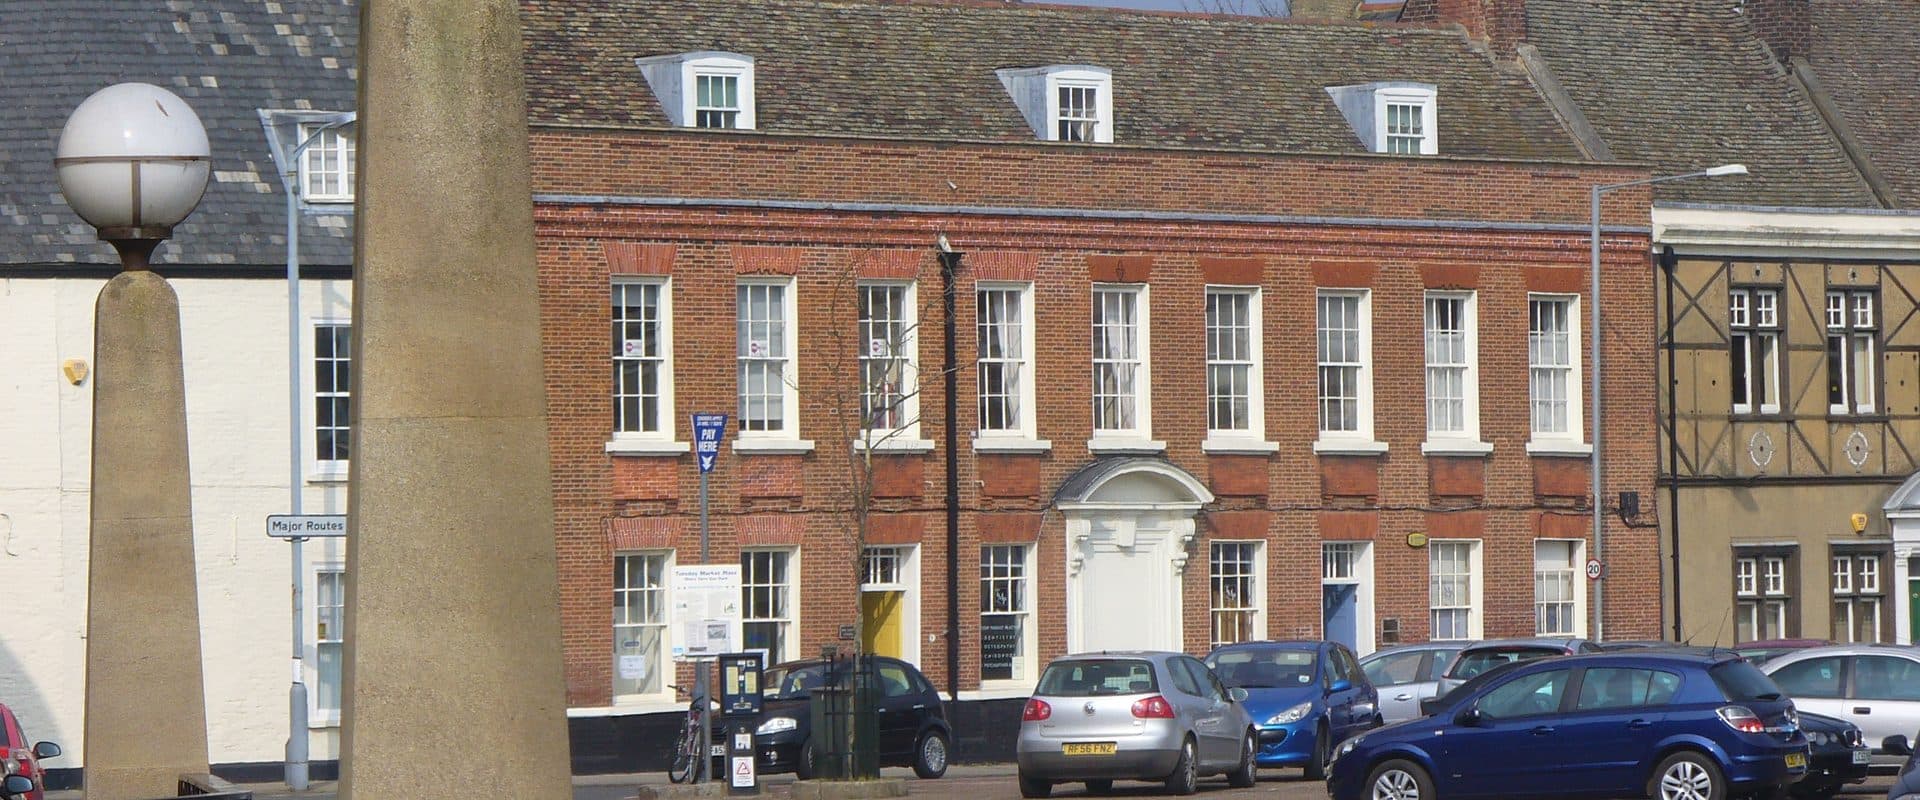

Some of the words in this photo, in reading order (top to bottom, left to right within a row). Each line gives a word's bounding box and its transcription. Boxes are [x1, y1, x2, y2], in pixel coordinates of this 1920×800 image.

[702, 429, 716, 440] PAY
[698, 441, 717, 452] HERE
[272, 521, 302, 532] Major
[306, 521, 344, 530] Routes
[1588, 564, 1599, 574] 20
[1068, 743, 1092, 753] RF56
